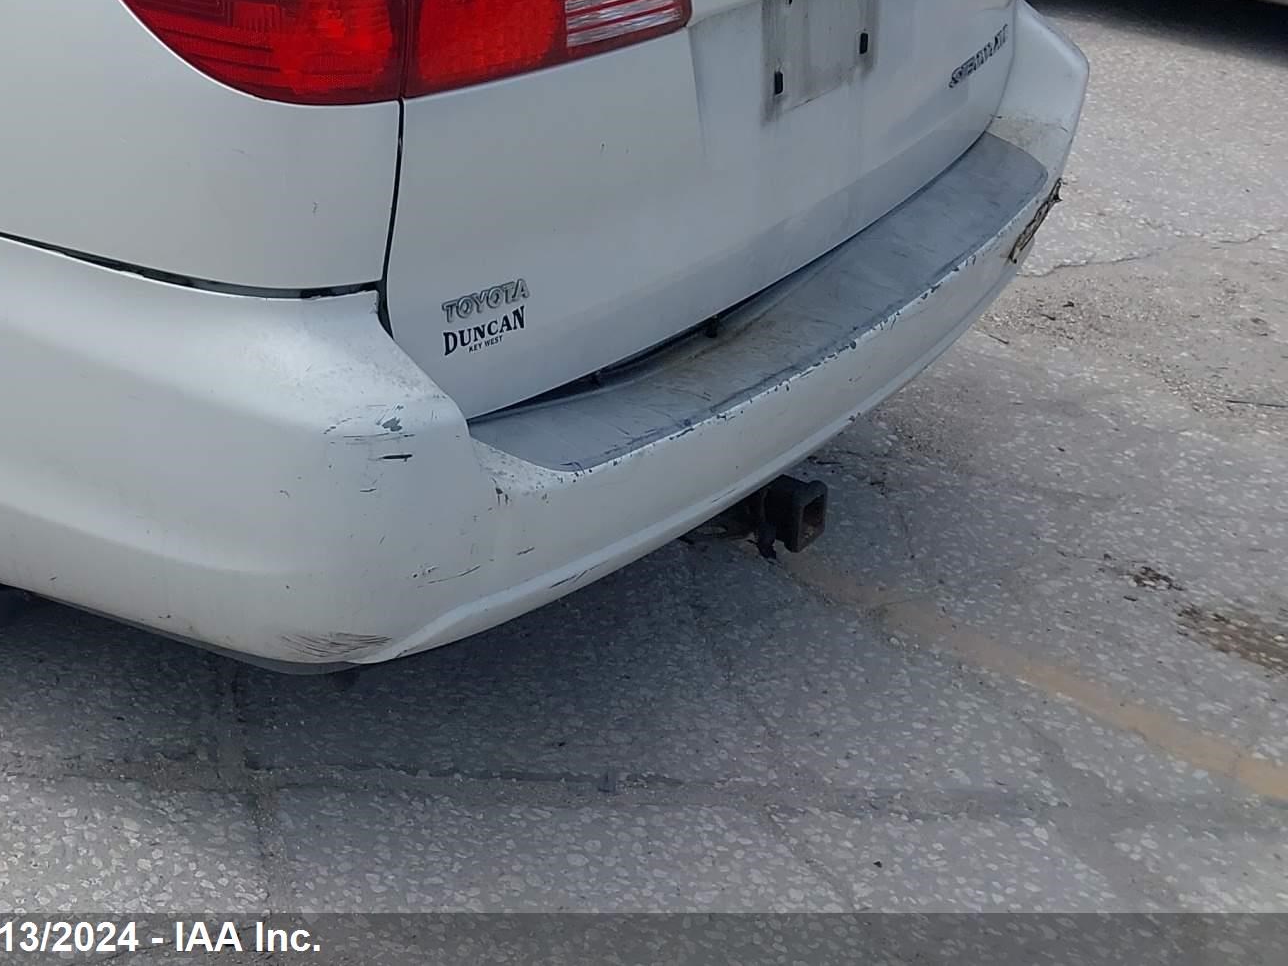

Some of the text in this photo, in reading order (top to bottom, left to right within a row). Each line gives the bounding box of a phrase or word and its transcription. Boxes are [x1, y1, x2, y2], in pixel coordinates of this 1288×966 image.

[441, 278, 530, 323] TOYOTA
[443, 305, 525, 356] DUNCAN
[468, 334, 503, 353] KEY WEST
